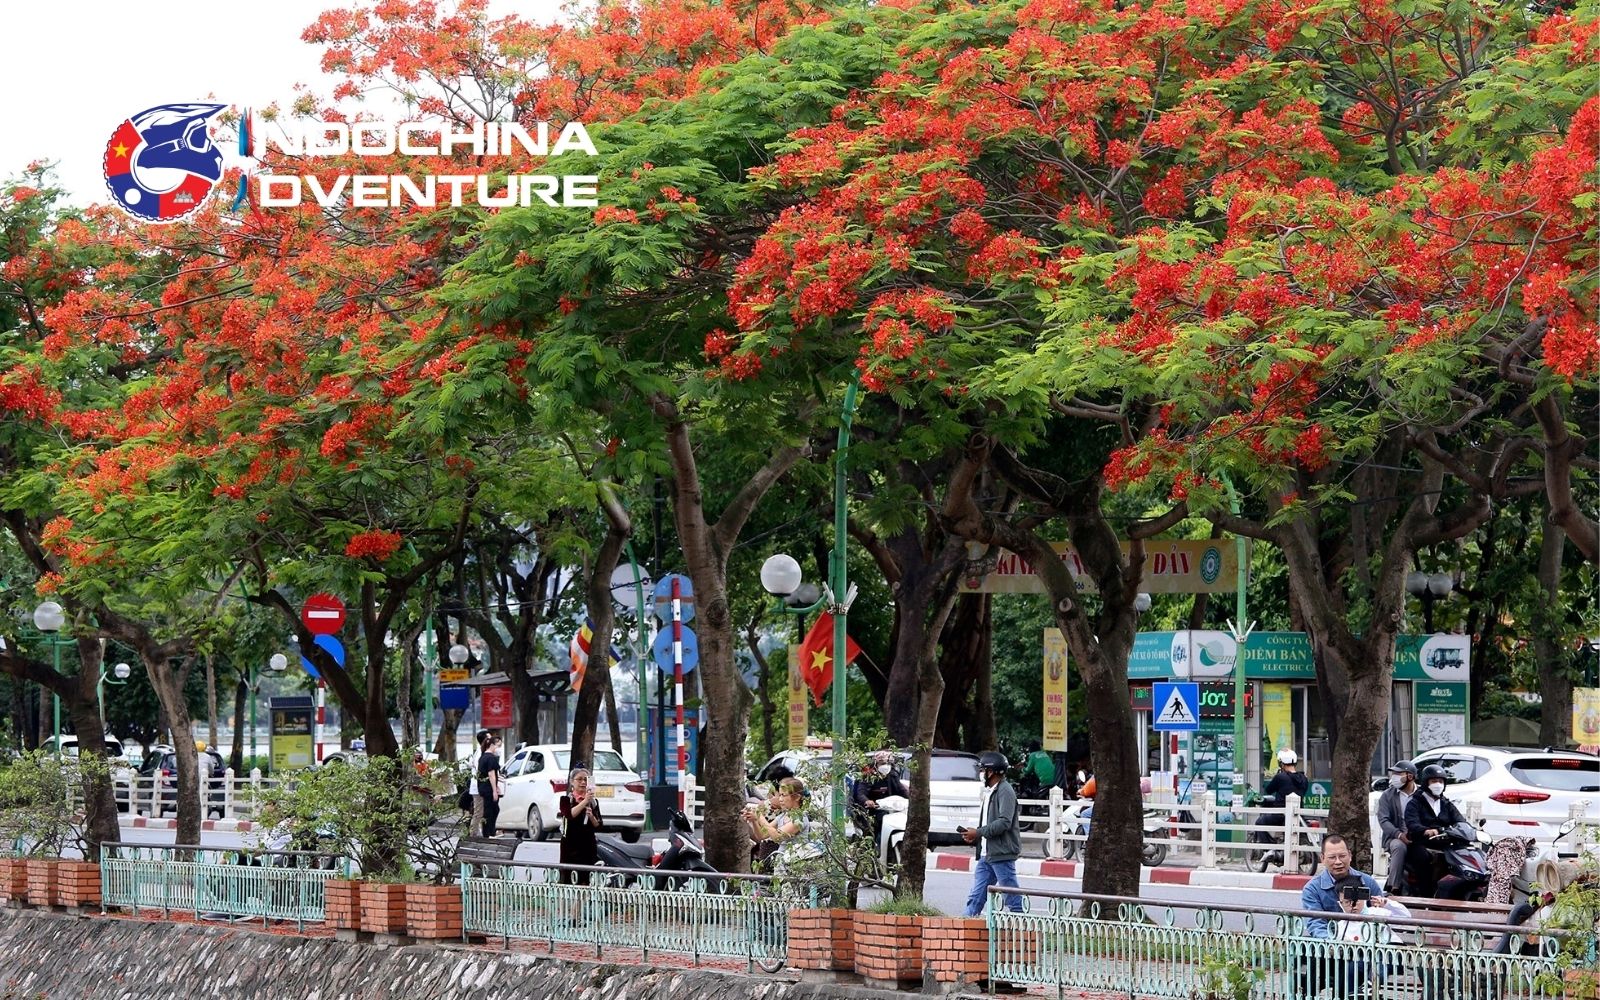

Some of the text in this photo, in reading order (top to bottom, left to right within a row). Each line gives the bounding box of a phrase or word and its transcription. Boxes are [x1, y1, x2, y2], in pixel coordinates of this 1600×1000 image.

[1266, 635, 1291, 645] CÔNG
[1293, 637, 1305, 645] TY
[1280, 647, 1307, 660] BÁN
[1396, 649, 1417, 664] IỆN
[1262, 663, 1304, 672] ELECTRIC
